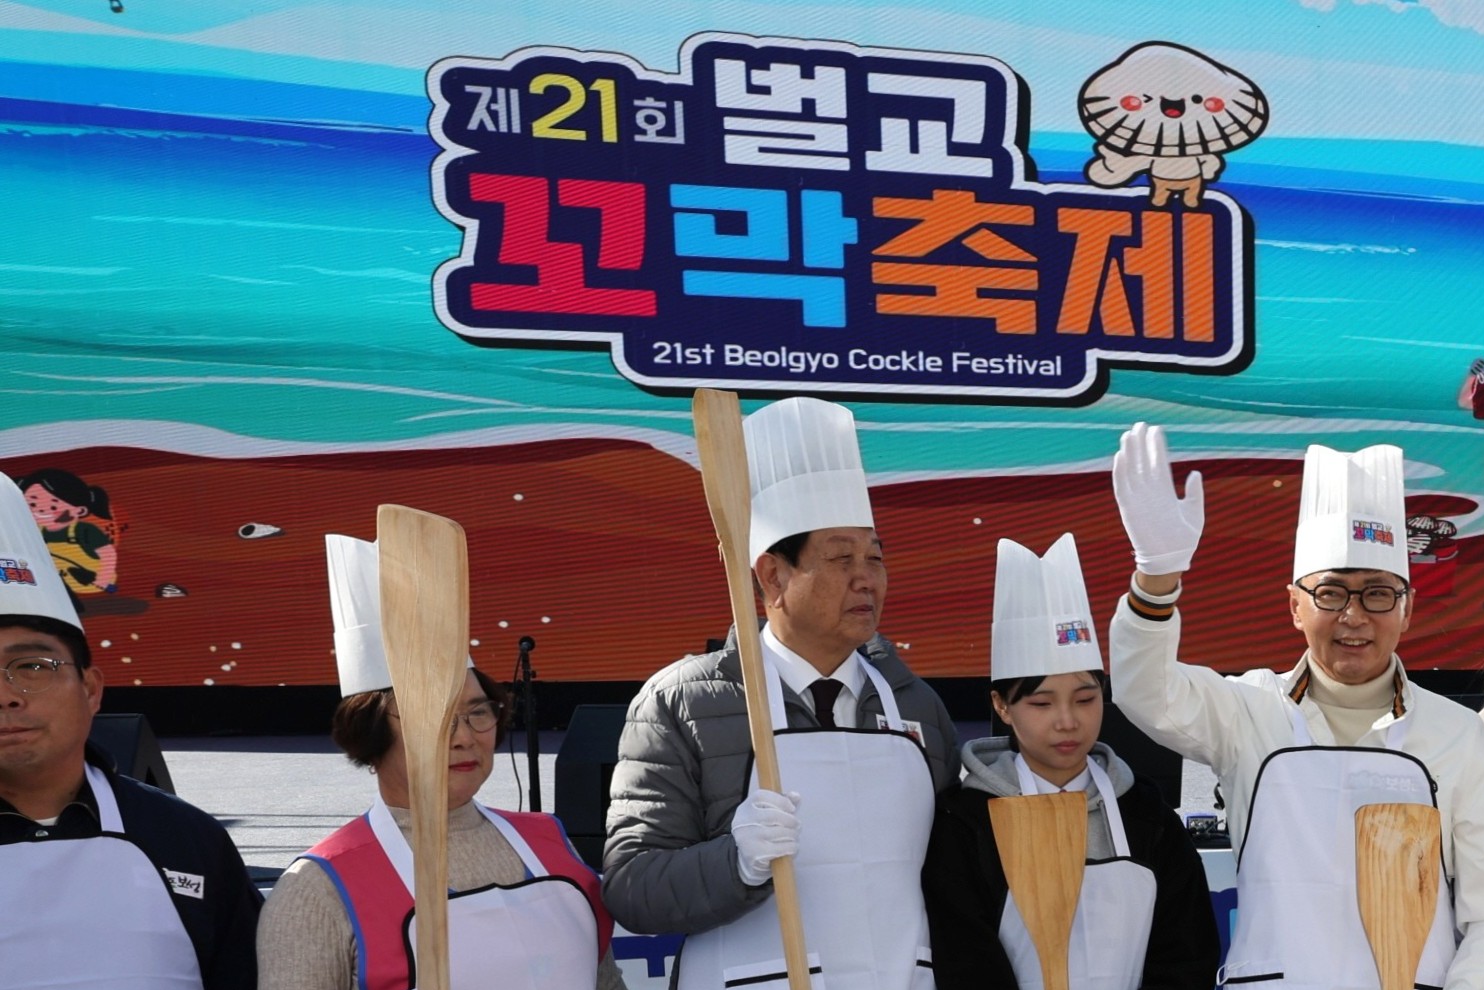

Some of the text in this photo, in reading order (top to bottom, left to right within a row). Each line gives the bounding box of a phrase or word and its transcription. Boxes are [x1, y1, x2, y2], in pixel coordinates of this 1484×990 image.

[464, 57, 993, 177] 제21회 벌교
[469, 172, 1214, 343] 꼬막축제
[652, 341, 1062, 377] 21st Beolgyo Cockle Festival
